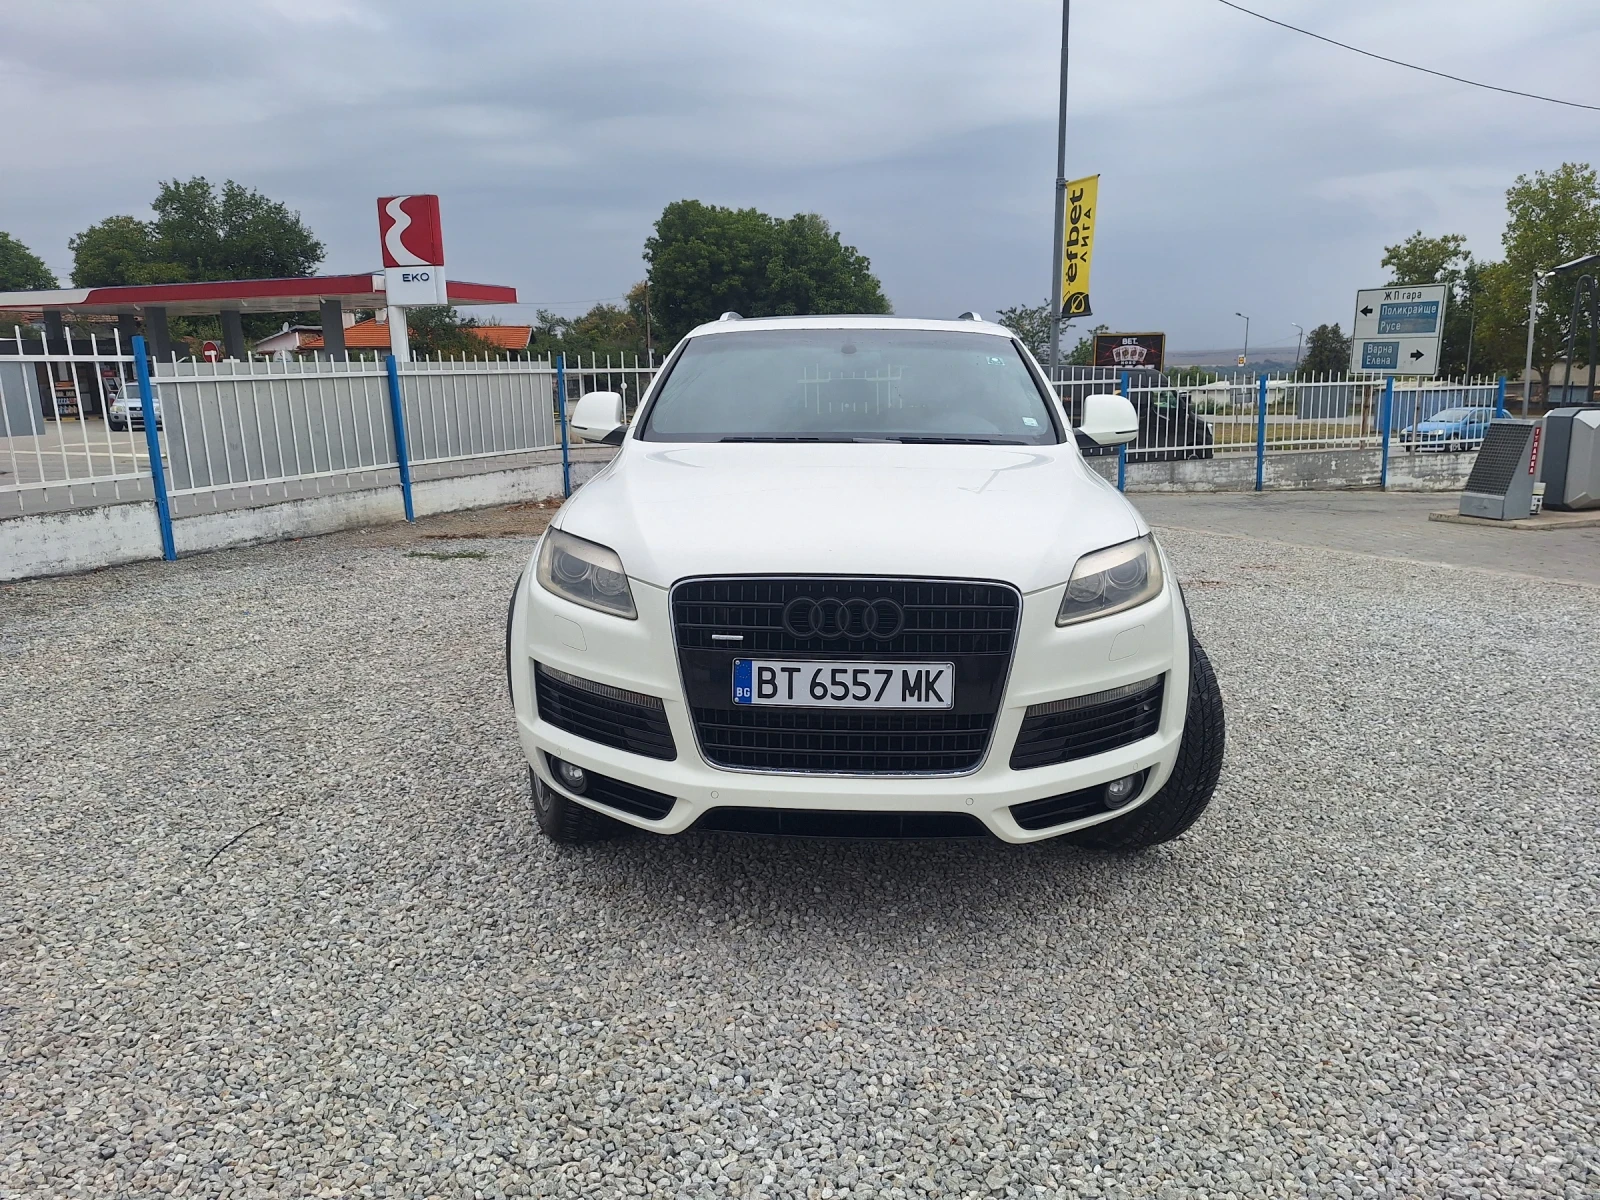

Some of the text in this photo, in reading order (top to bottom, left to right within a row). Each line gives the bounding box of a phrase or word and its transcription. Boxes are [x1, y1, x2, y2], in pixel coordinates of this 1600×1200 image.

[1065, 187, 1084, 284] efbet
[402, 272, 430, 282] EKO
[1402, 291, 1422, 302] гара
[1381, 305, 1437, 317] Поликрайще
[1380, 321, 1401, 333] Русе
[1367, 344, 1393, 355] Варна
[1366, 355, 1391, 365] Елена
[757, 666, 945, 703] BT 6557 MK
[736, 687, 751, 698] BG
